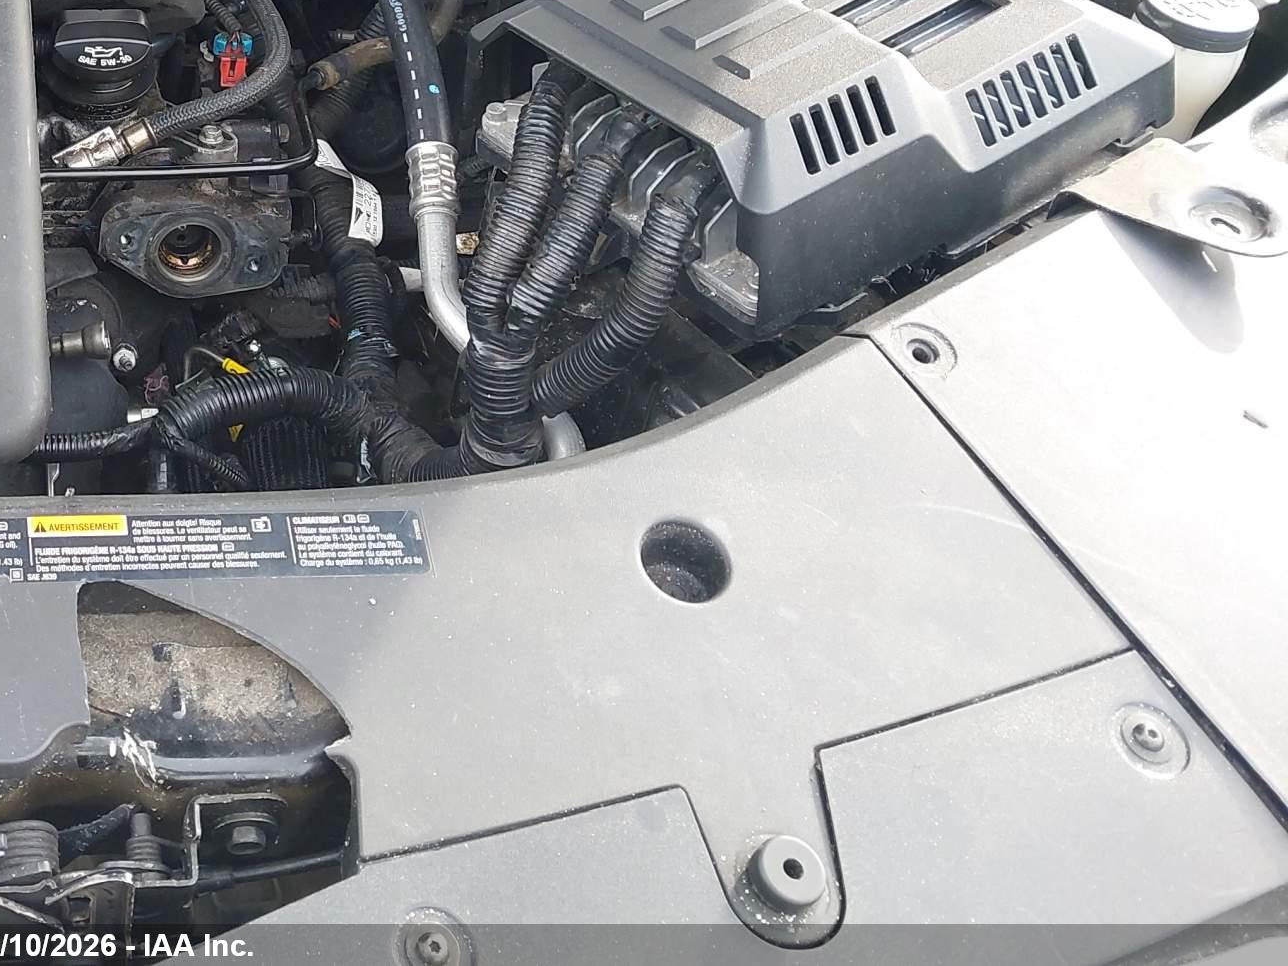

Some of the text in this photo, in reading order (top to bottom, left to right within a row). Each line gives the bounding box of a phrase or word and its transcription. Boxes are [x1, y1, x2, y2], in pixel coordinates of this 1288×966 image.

[78, 54, 133, 66] SAE 5W-30
[48, 522, 119, 532] AVERTISSEMENT
[132, 519, 161, 527] Attention
[199, 518, 221, 527] Risque
[186, 525, 221, 534] ventilateur
[222, 525, 237, 534] peut
[8, 532, 21, 540] and
[187, 534, 204, 542] sans
[332, 533, 358, 541] R-134a
[34, 547, 60, 556] FLUIDE
[109, 545, 136, 554] R-134a
[136, 544, 156, 553] SOUS
[157, 544, 181, 553] HAUTE
[182, 543, 218, 552] PRESSION
[13, 557, 23, 566] lb)
[71, 556, 81, 564] du
[111, 554, 124, 563] doit
[124, 553, 139, 563] être
[168, 554, 180, 563] par
[191, 552, 224, 562] personnel
[385, 555, 395, 566] kg
[35, 564, 50, 573] Des
[50, 563, 84, 573] méthodes
[84, 562, 121, 572] d'entretien
[122, 561, 159, 571] incorrectes
[160, 561, 188, 571] peuvent
[188, 561, 211, 569] causer
[211, 560, 225, 569] des
[26, 572, 40, 581] SAE
